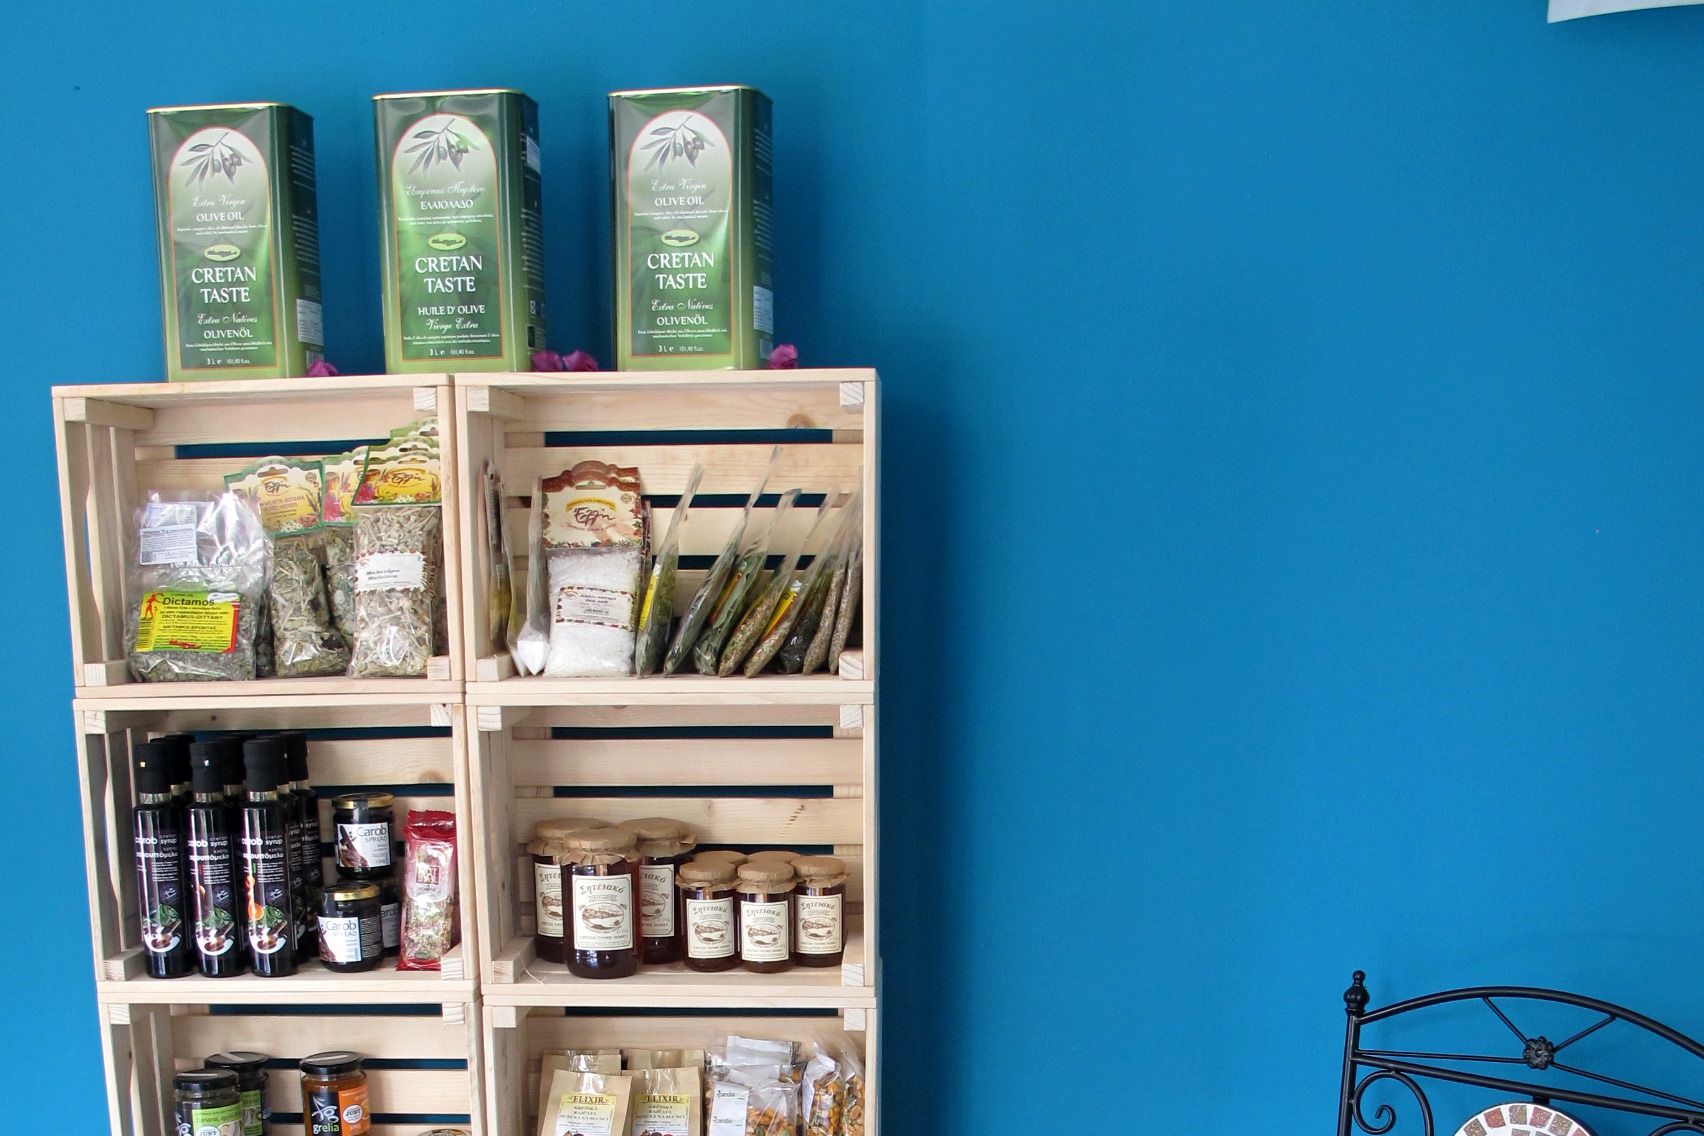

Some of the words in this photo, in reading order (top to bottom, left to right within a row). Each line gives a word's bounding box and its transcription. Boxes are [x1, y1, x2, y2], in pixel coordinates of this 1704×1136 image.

[679, 179, 706, 194] Virgin
[219, 194, 245, 210] Virgin
[421, 200, 474, 210] ΕΛΑΙΟΛΑΔΟ
[655, 197, 685, 207] OLIVE
[687, 196, 704, 206] OIL
[197, 212, 226, 222] OLIVE
[228, 212, 244, 221] OIL
[415, 255, 482, 273] CRETAN
[648, 252, 714, 269] CRETAN
[192, 266, 256, 284] CRETAN
[424, 277, 476, 293] TASTE
[656, 273, 707, 290] TASTE
[200, 286, 250, 304] TASTE
[418, 306, 445, 316] HUILE
[458, 305, 485, 314] OLIVE
[651, 299, 674, 311] Extra
[198, 312, 220, 325] Extra
[657, 314, 708, 326] OLIVENÖL
[204, 327, 253, 339] OLIVENÖL
[163, 597, 215, 606] Dictamos
[358, 825, 387, 837] Carob
[135, 836, 158, 844] crob
[188, 839, 208, 847] caob
[242, 837, 263, 845] cob
[580, 883, 625, 895] Σητειακό
[381, 907, 399, 917] arob
[326, 920, 356, 931] Carob
[313, 1123, 339, 1134] grelia
